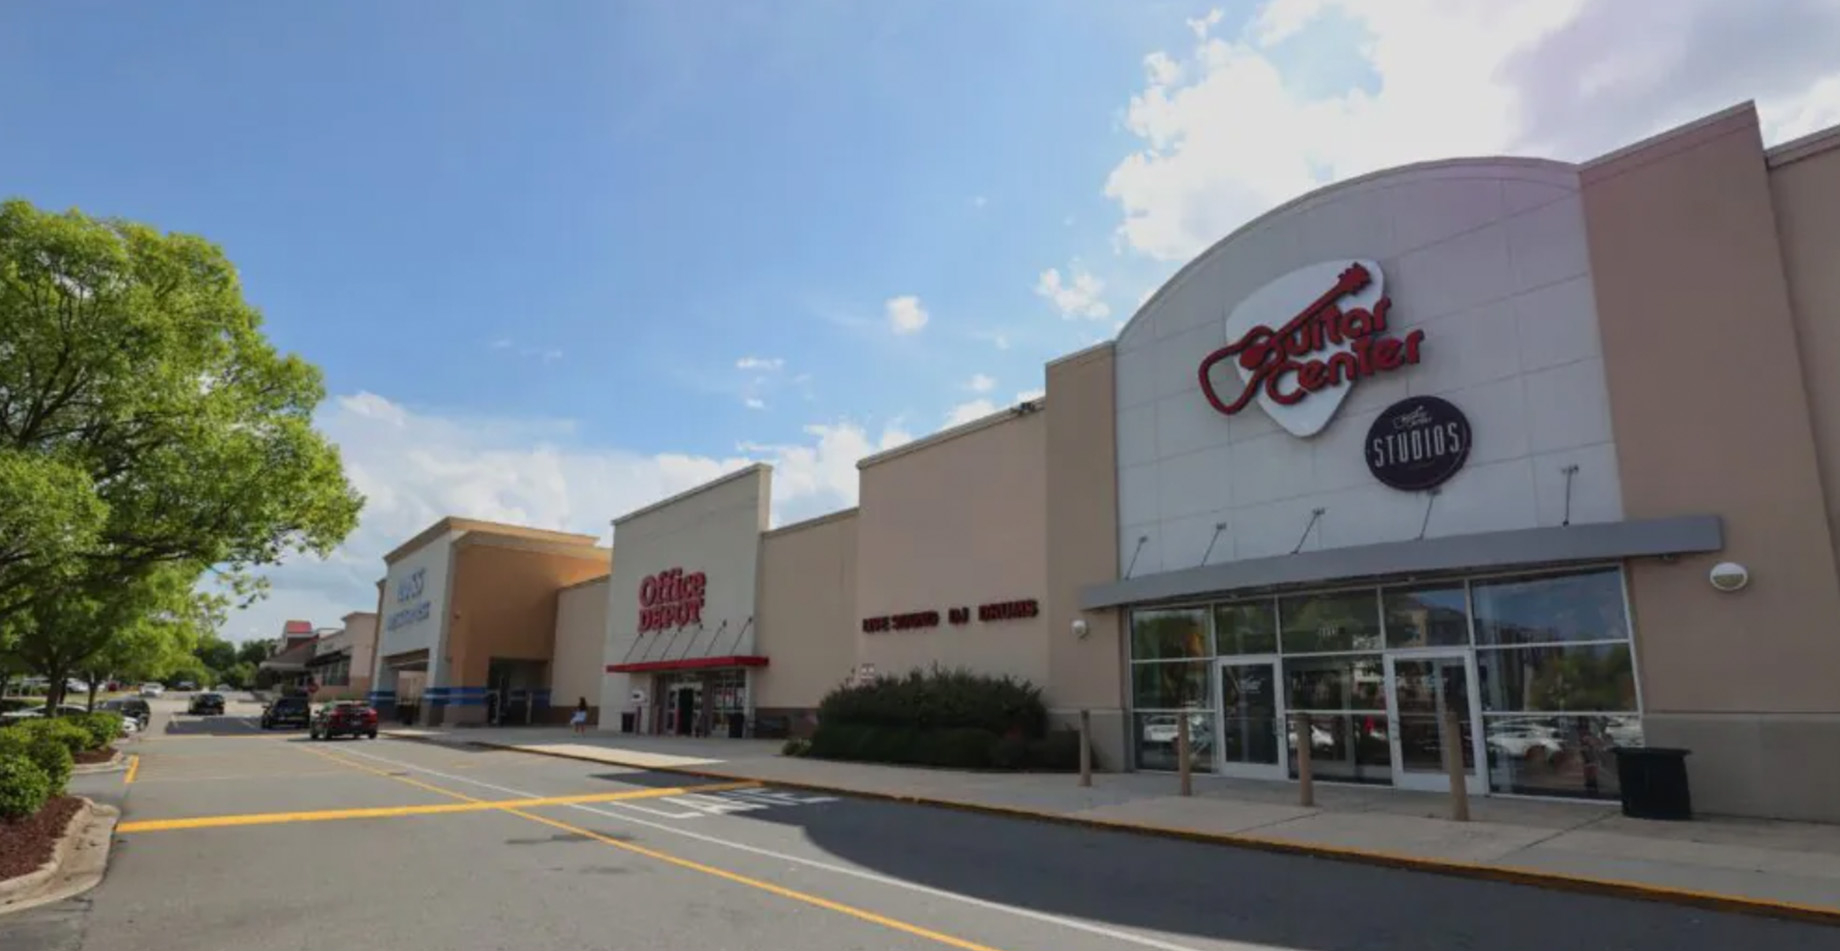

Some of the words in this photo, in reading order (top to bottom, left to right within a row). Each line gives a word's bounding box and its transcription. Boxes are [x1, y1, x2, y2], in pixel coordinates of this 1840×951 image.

[1198, 262, 1392, 416] Guitar
[1266, 329, 1425, 405] Center
[1373, 421, 1461, 468] STUDIOS
[639, 567, 706, 607] Office
[638, 599, 705, 633] DEPOT
